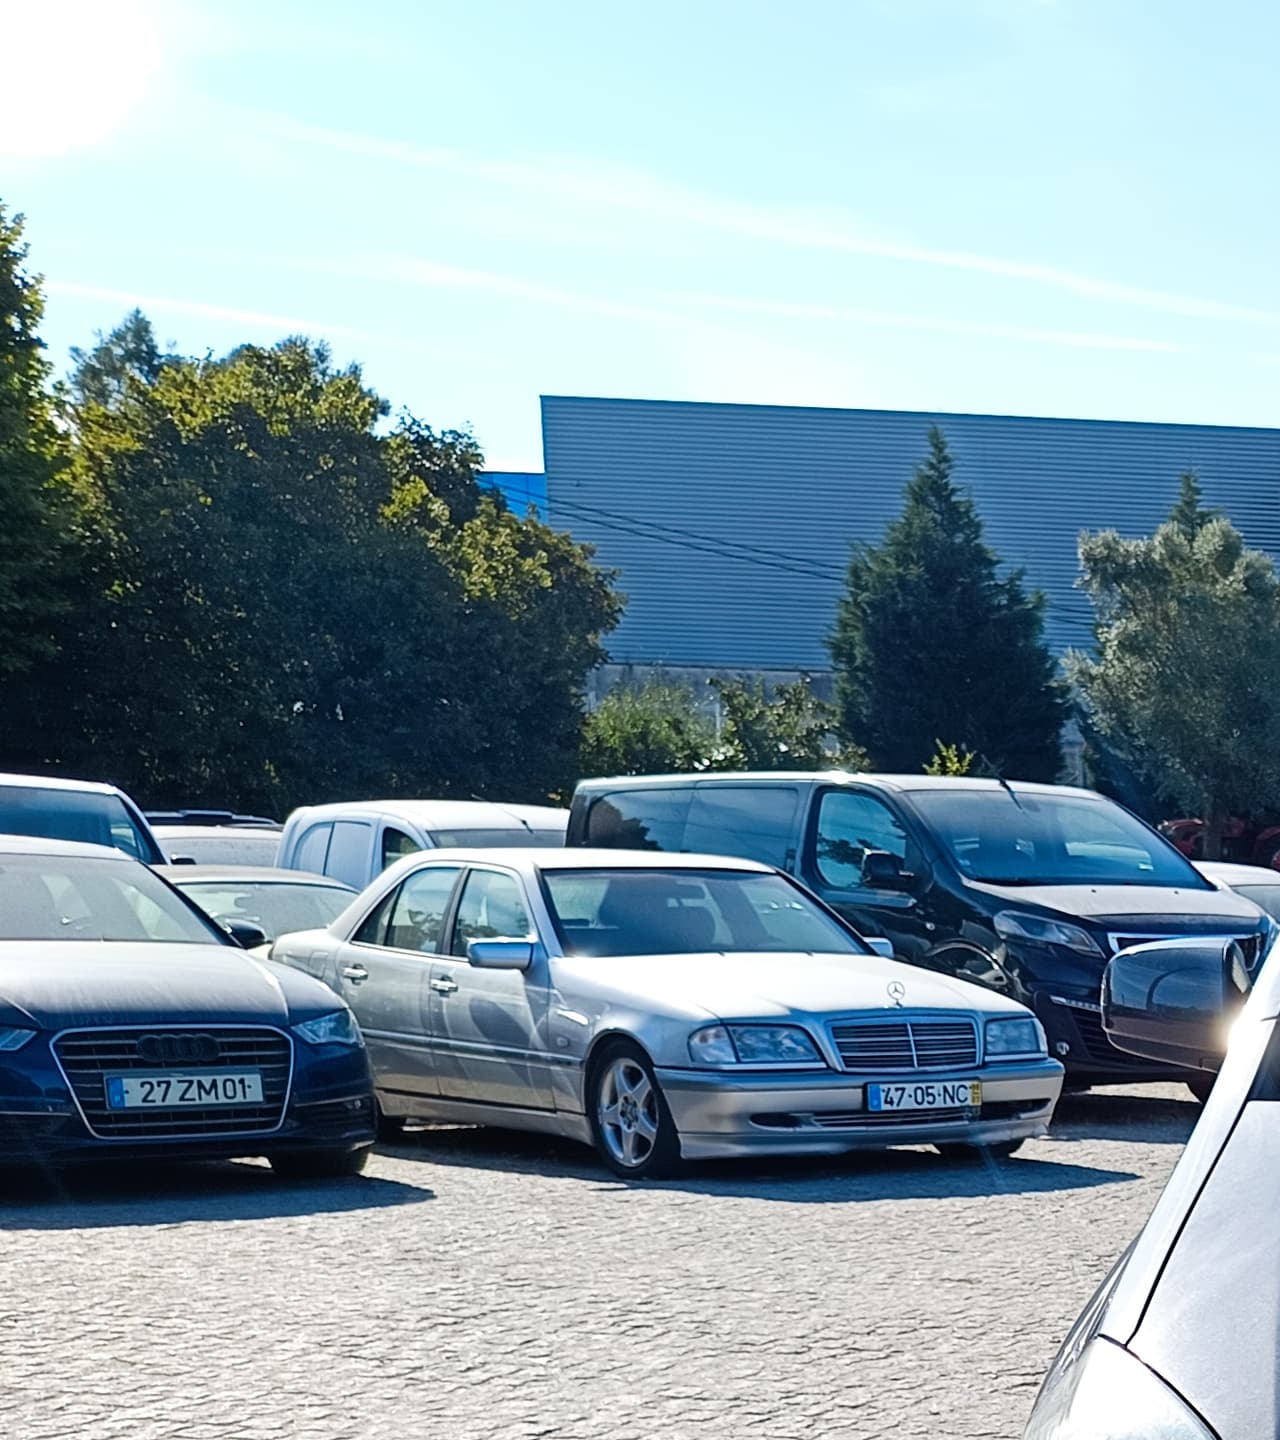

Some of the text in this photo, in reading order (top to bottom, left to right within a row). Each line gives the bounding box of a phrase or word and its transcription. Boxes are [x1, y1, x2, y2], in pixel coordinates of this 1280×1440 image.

[139, 1077, 248, 1103] 27 ZM 01
